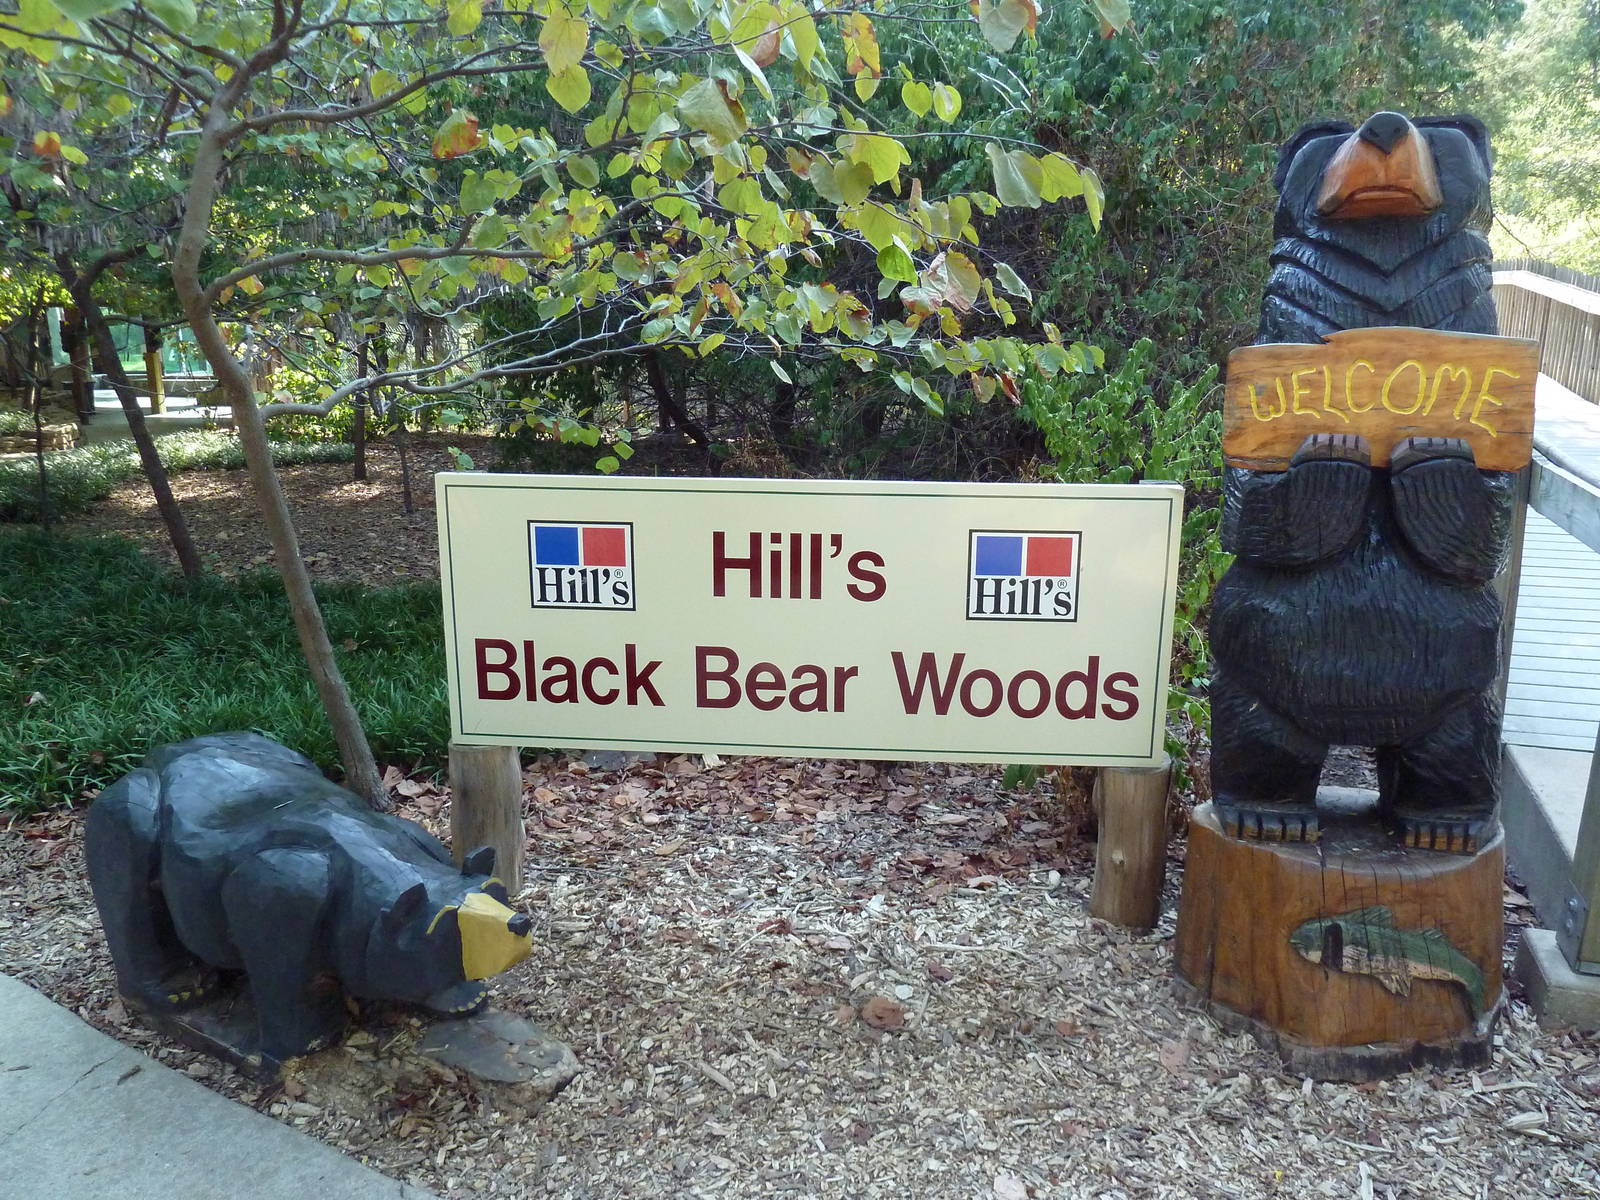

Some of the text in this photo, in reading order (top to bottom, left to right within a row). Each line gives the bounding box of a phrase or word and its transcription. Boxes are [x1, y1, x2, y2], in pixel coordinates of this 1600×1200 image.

[1248, 359, 1520, 438] WELCOME
[535, 567, 630, 606] Hill's
[712, 531, 887, 602] Hill's
[972, 577, 1072, 617] Hill's
[474, 638, 1140, 721] Black Bear Woods
